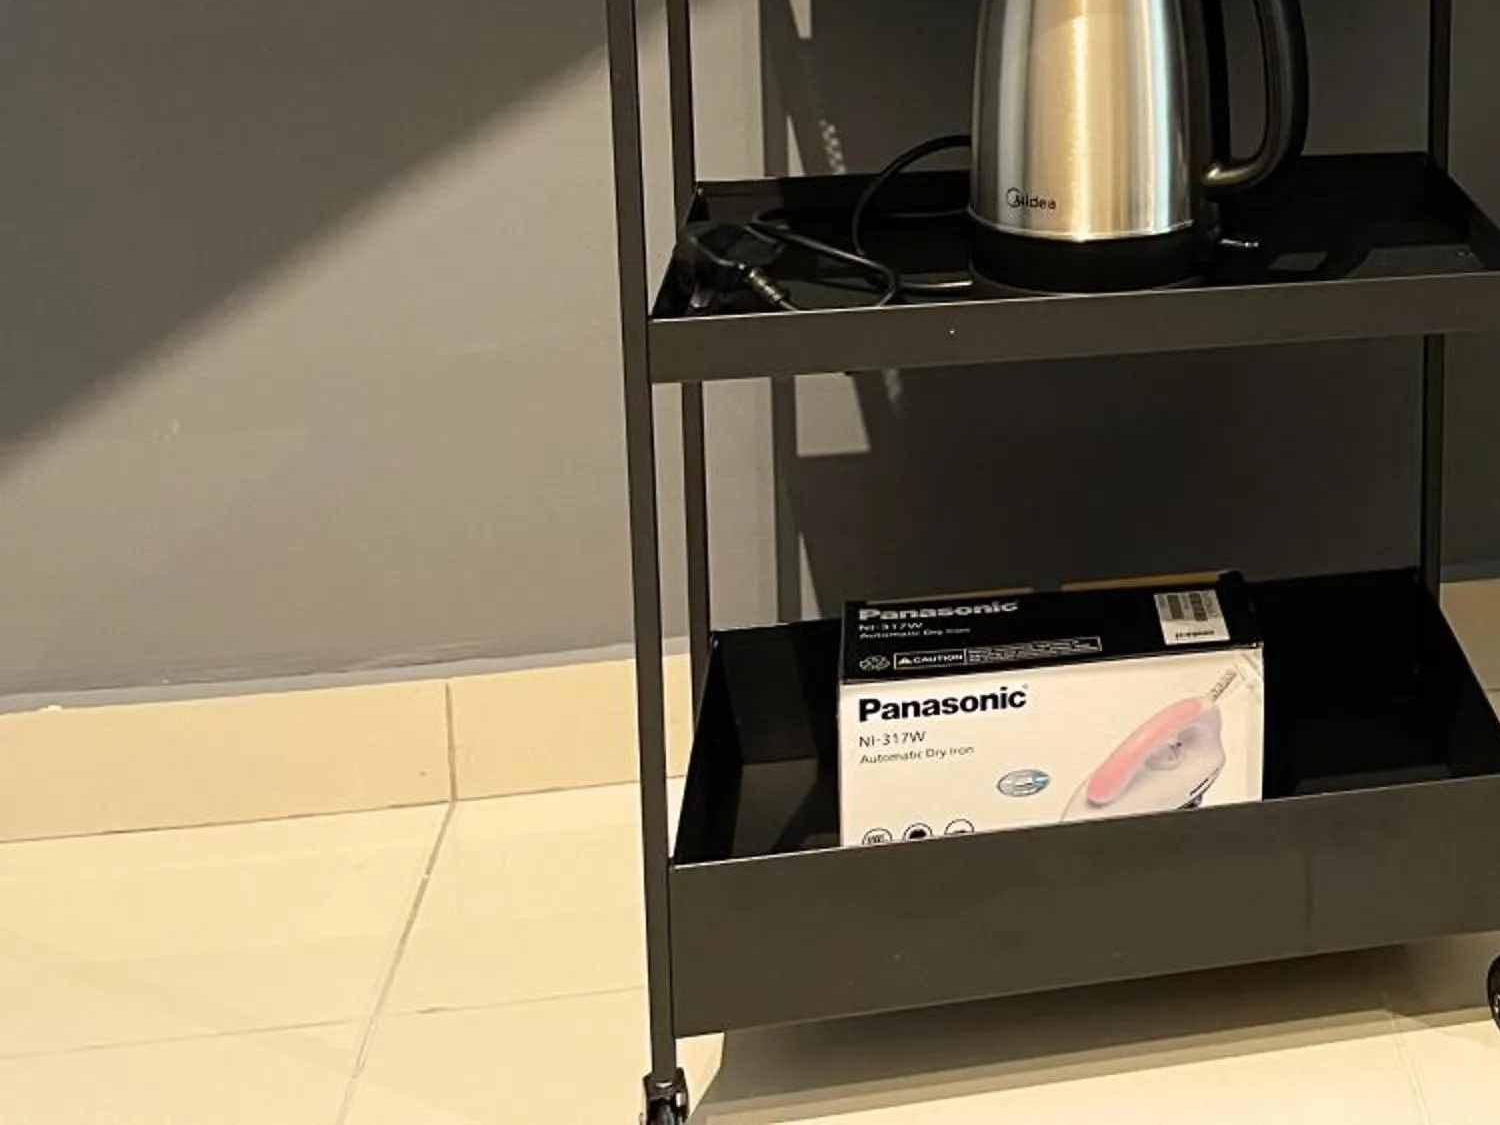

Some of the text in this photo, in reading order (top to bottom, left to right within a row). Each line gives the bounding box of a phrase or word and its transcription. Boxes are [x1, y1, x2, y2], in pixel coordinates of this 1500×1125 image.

[858, 600, 1019, 622] Panasonic
[913, 654, 963, 664] CAUTION
[858, 686, 1027, 723] Panasonic
[858, 730, 927, 748] NI-317W
[859, 750, 923, 764] Automatic
[925, 747, 947, 759] Dry
